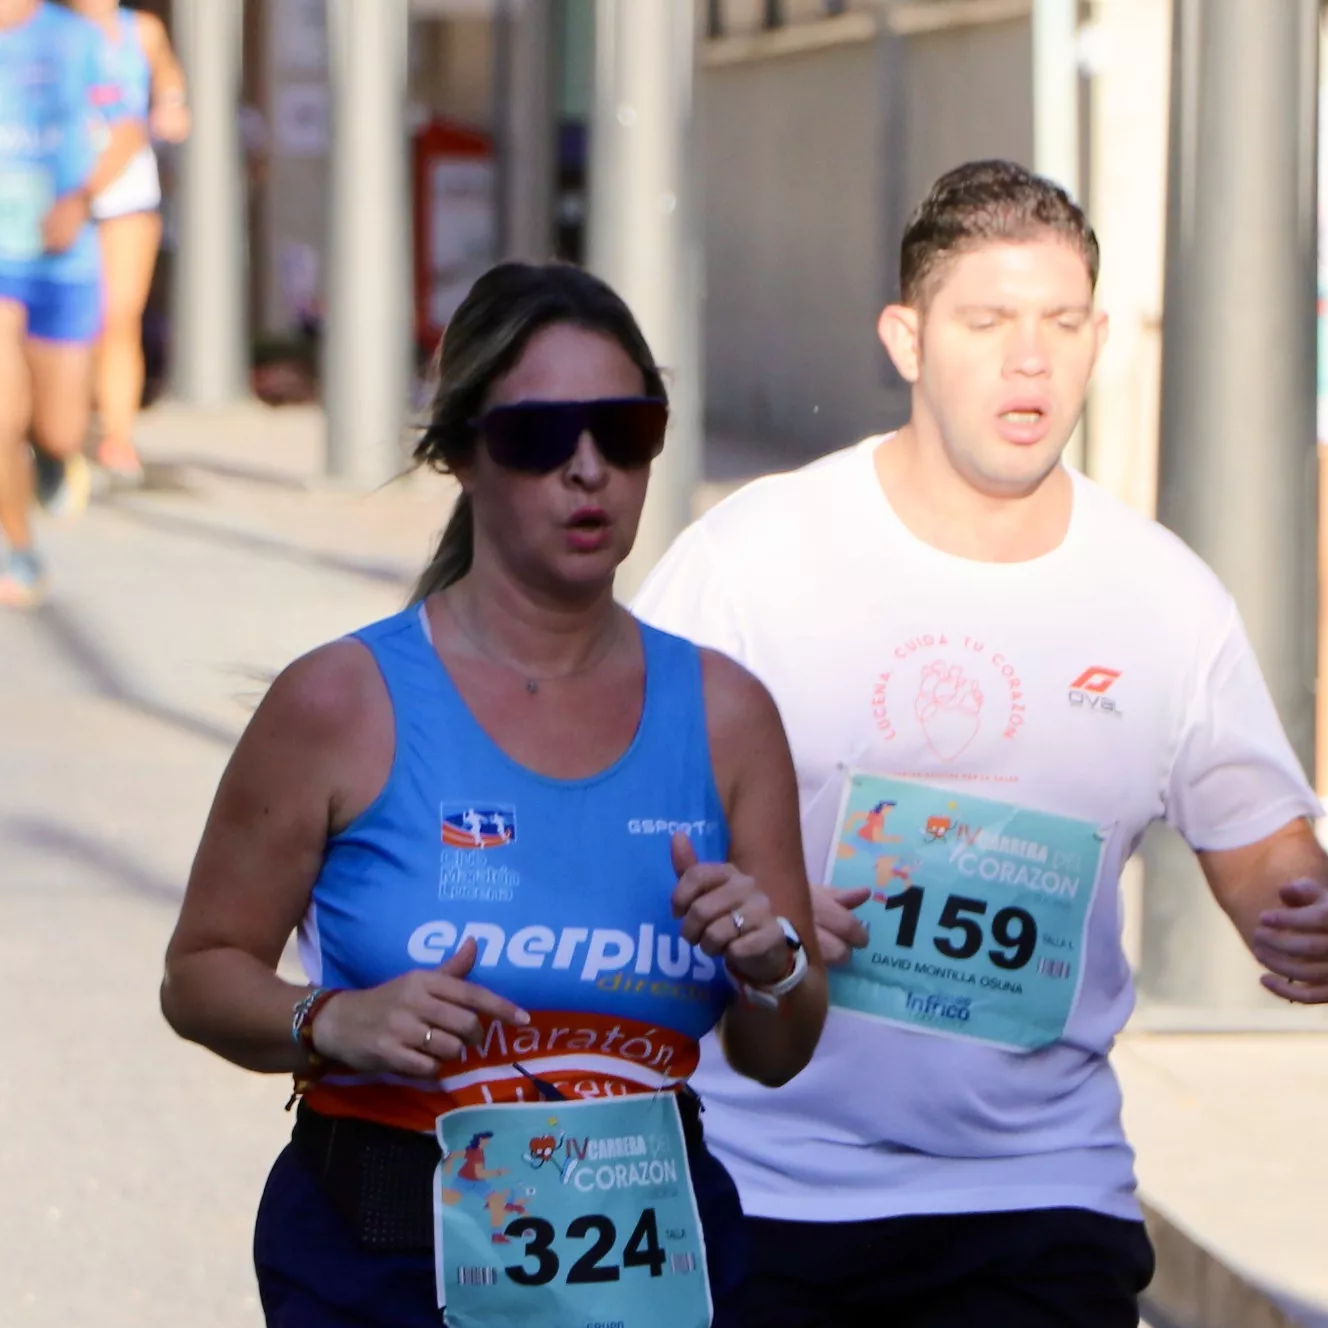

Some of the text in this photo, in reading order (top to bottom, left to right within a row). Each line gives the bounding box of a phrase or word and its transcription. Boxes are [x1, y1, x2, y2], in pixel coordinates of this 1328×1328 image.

[894, 633, 949, 659] CUIDA
[964, 636, 984, 652] TU
[956, 823, 983, 846] IV
[407, 920, 715, 981] enerplus
[884, 885, 1038, 971] 159
[871, 952, 1023, 995] DAVID MONTILLA OSUNA
[460, 1019, 674, 1066] Maratón
[566, 1137, 589, 1160] IV
[587, 1135, 647, 1160] CARRERA
[504, 1207, 666, 1286] 324
